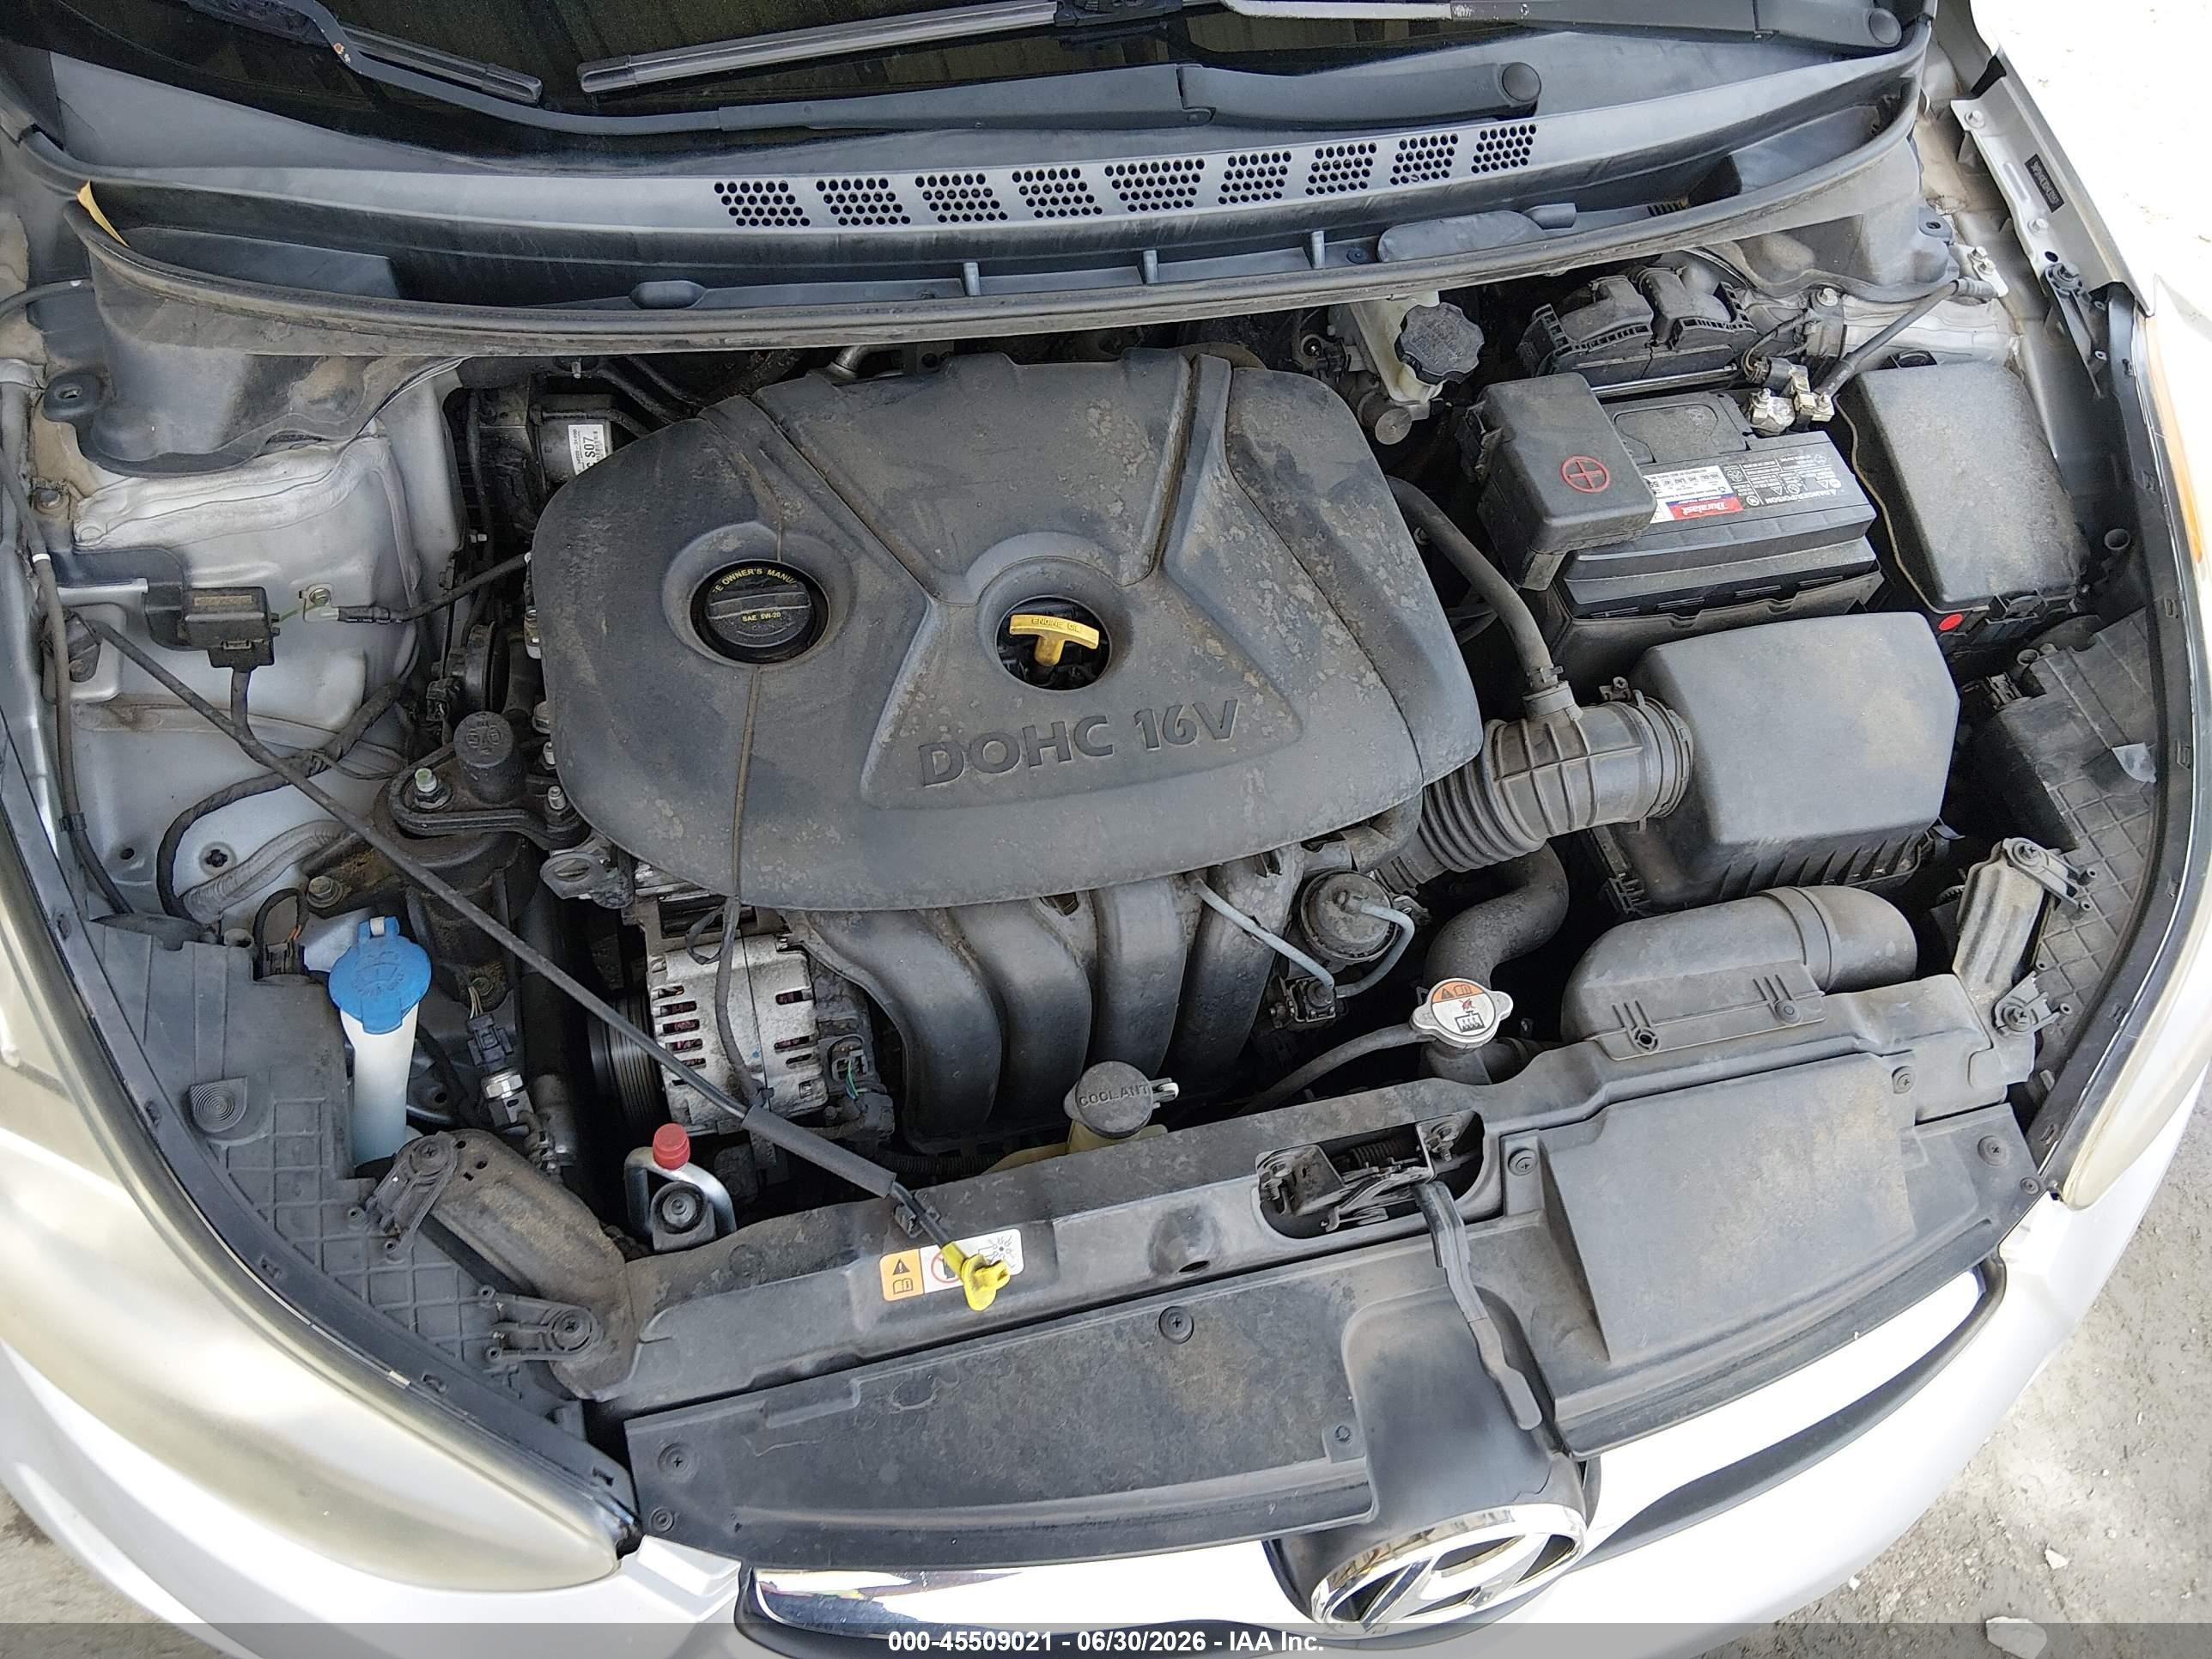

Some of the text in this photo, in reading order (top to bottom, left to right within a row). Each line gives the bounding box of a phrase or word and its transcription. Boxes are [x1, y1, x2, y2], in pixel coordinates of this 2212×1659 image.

[583, 436, 596, 458] S07
[1681, 501, 1728, 516] Duralast
[721, 568, 763, 586] OWNER'S
[760, 611, 781, 621] 5W-20
[1031, 617, 1080, 633] ENGINE OIL
[919, 699, 1239, 787] DOHC 16V
[1079, 1083, 1149, 1107] COOLANT
